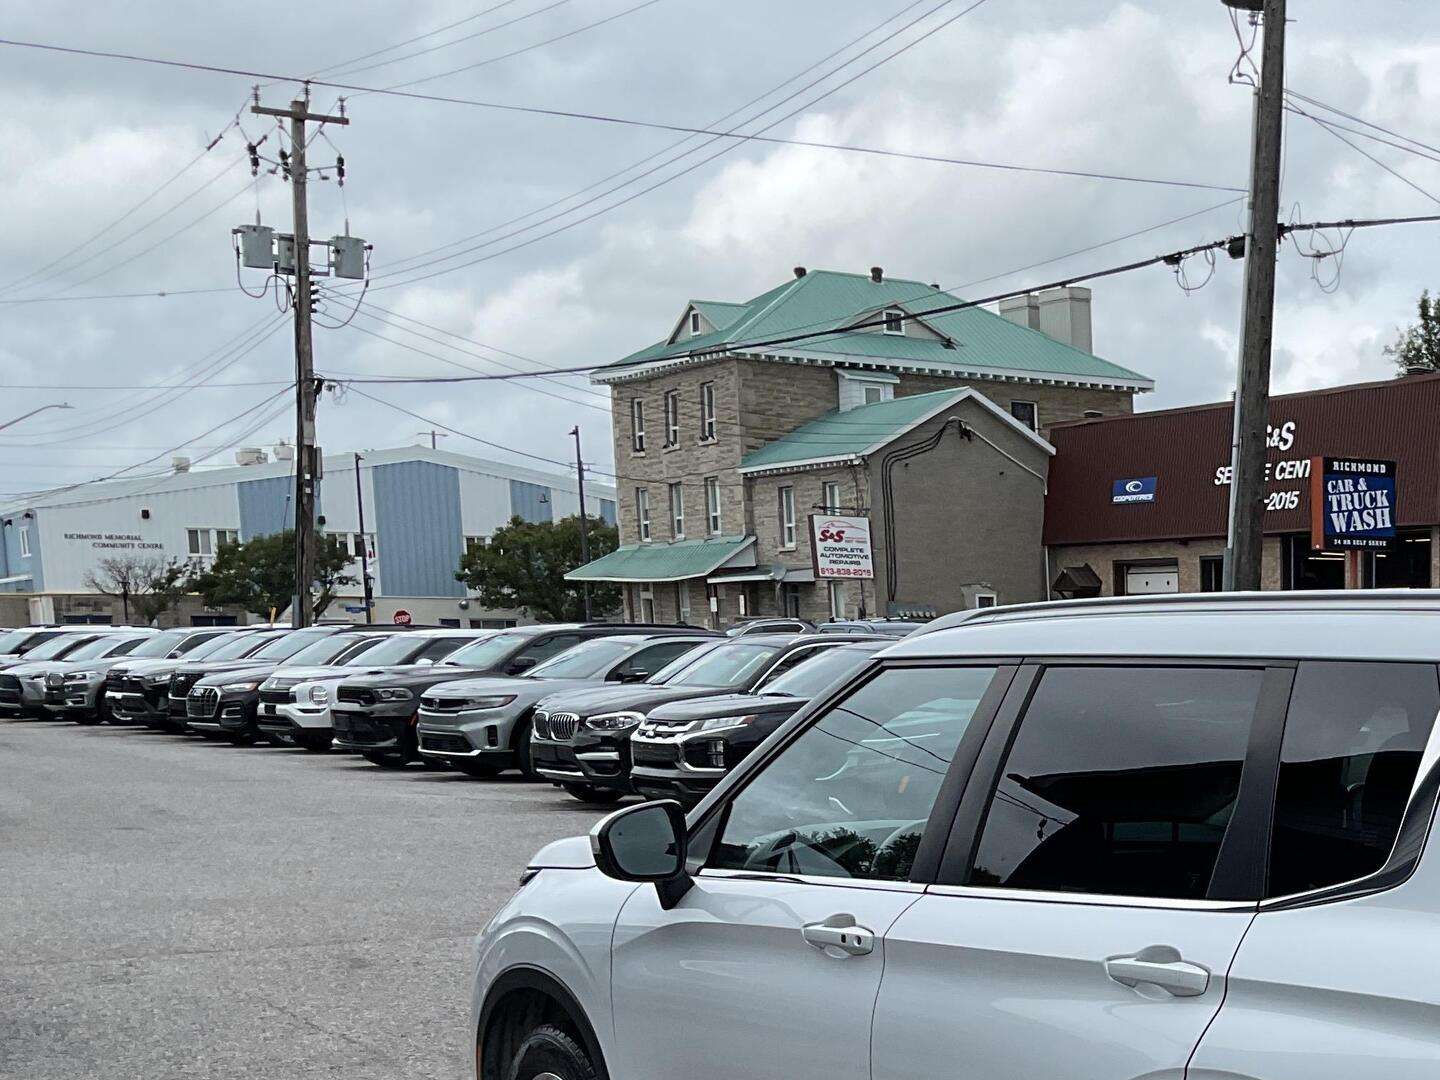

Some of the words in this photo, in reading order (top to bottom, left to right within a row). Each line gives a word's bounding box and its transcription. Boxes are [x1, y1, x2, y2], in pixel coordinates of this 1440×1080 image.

[1275, 459, 1311, 480] CENT
[1333, 461, 1386, 473] RICHMOND
[1327, 479, 1354, 494] CAR
[1357, 477, 1368, 491] &
[1328, 489, 1389, 512] TRUCK
[1330, 507, 1392, 533] WASH
[820, 552, 870, 560] AUTOMOTIVE
[823, 546, 865, 554] COMPLETE
